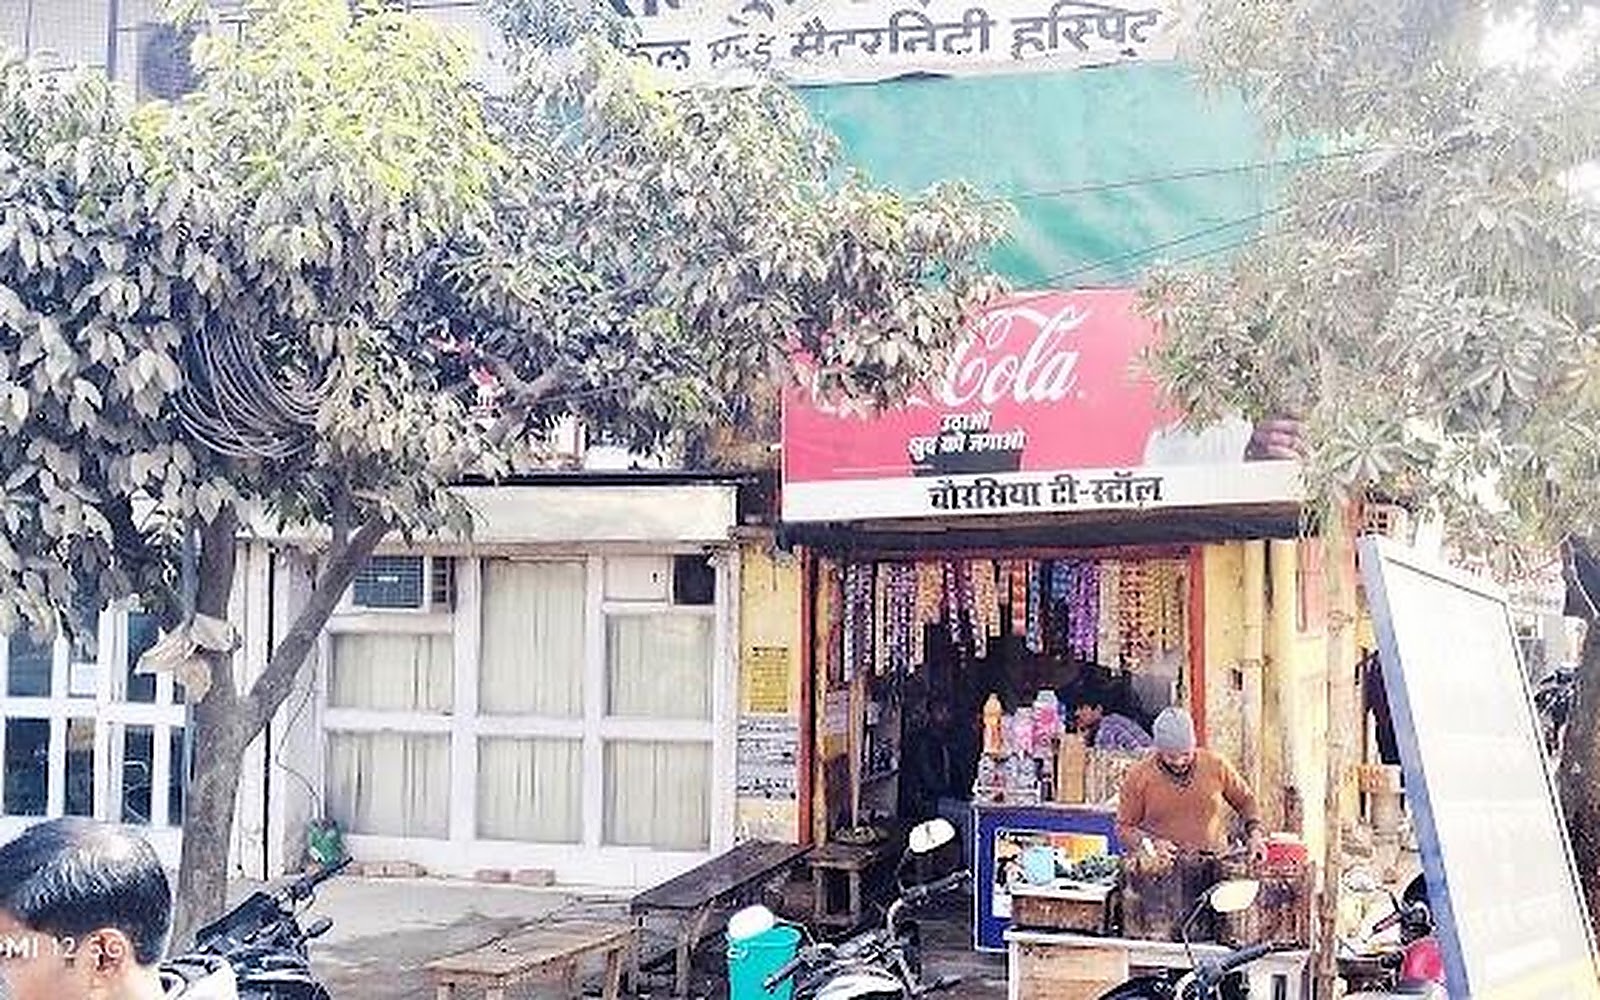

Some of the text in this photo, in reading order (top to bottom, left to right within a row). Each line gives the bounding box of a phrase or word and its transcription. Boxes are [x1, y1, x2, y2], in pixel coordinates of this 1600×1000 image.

[790, 16, 996, 57] मैटरनिटी
[940, 411, 993, 431] उठाओ
[908, 428, 1025, 462] खुद को जगाओ
[927, 478, 1042, 511] चौरसिया
